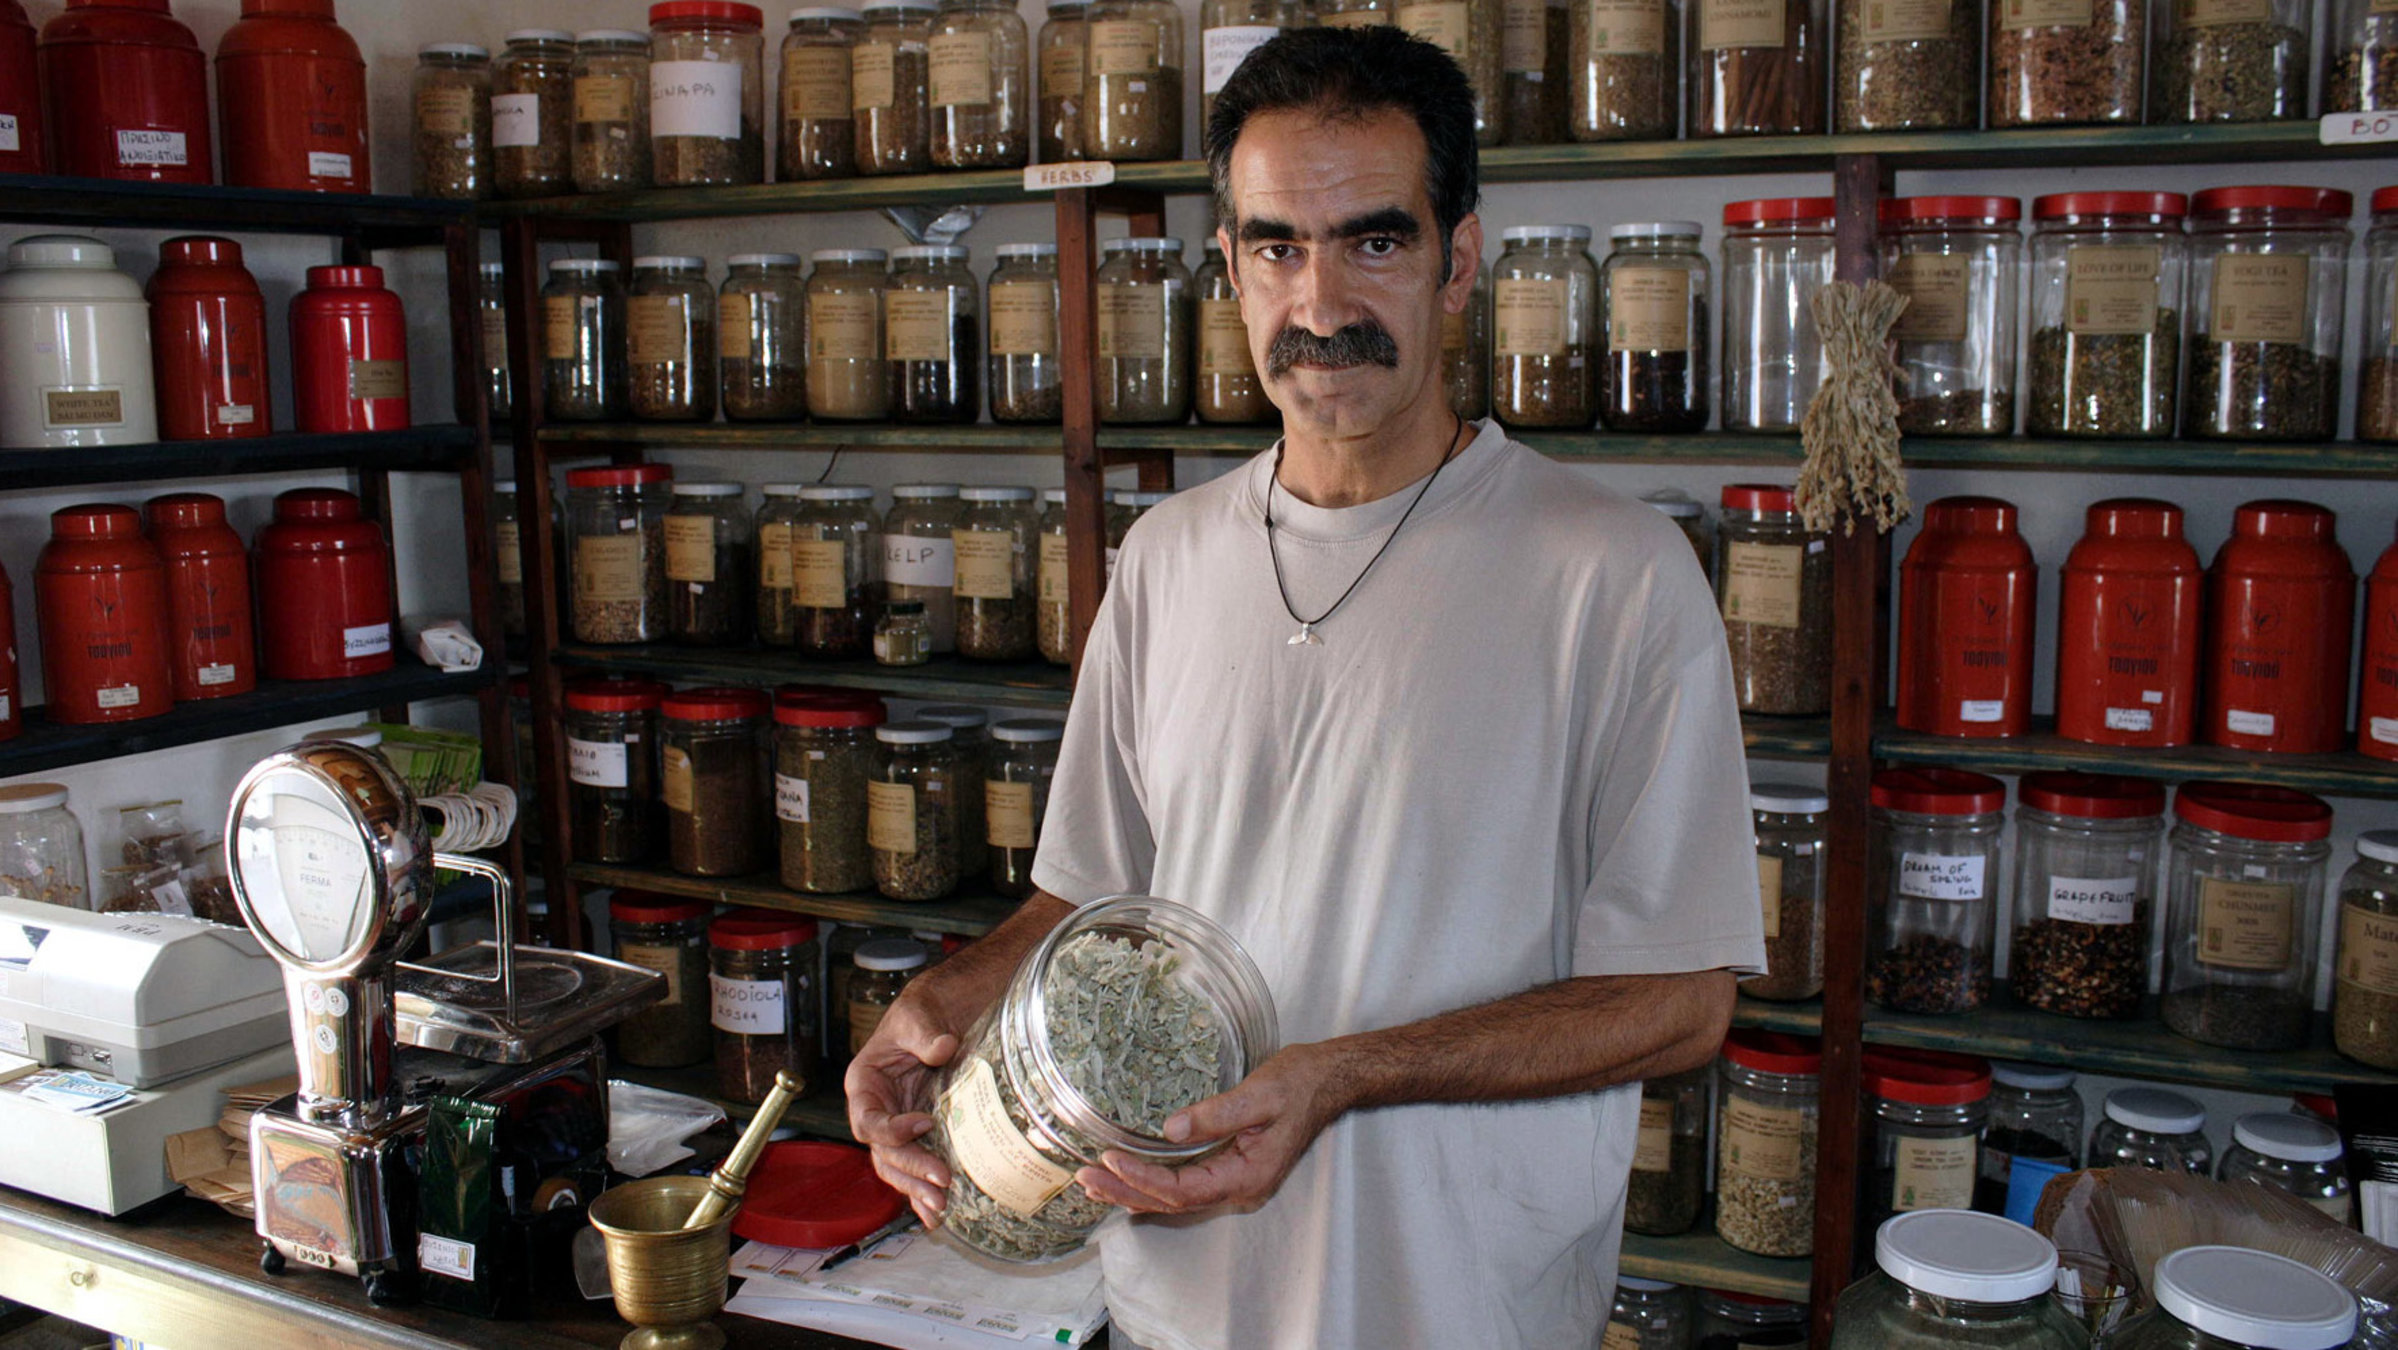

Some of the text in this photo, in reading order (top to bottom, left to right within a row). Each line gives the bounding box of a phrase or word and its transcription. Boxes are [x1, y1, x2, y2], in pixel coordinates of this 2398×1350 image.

[2077, 263, 2148, 273] LOVE OF LIFE
[2266, 266, 2288, 276] TEA
[1904, 861, 1967, 875] DREAM OF
[300, 873, 332, 887] FERMA
